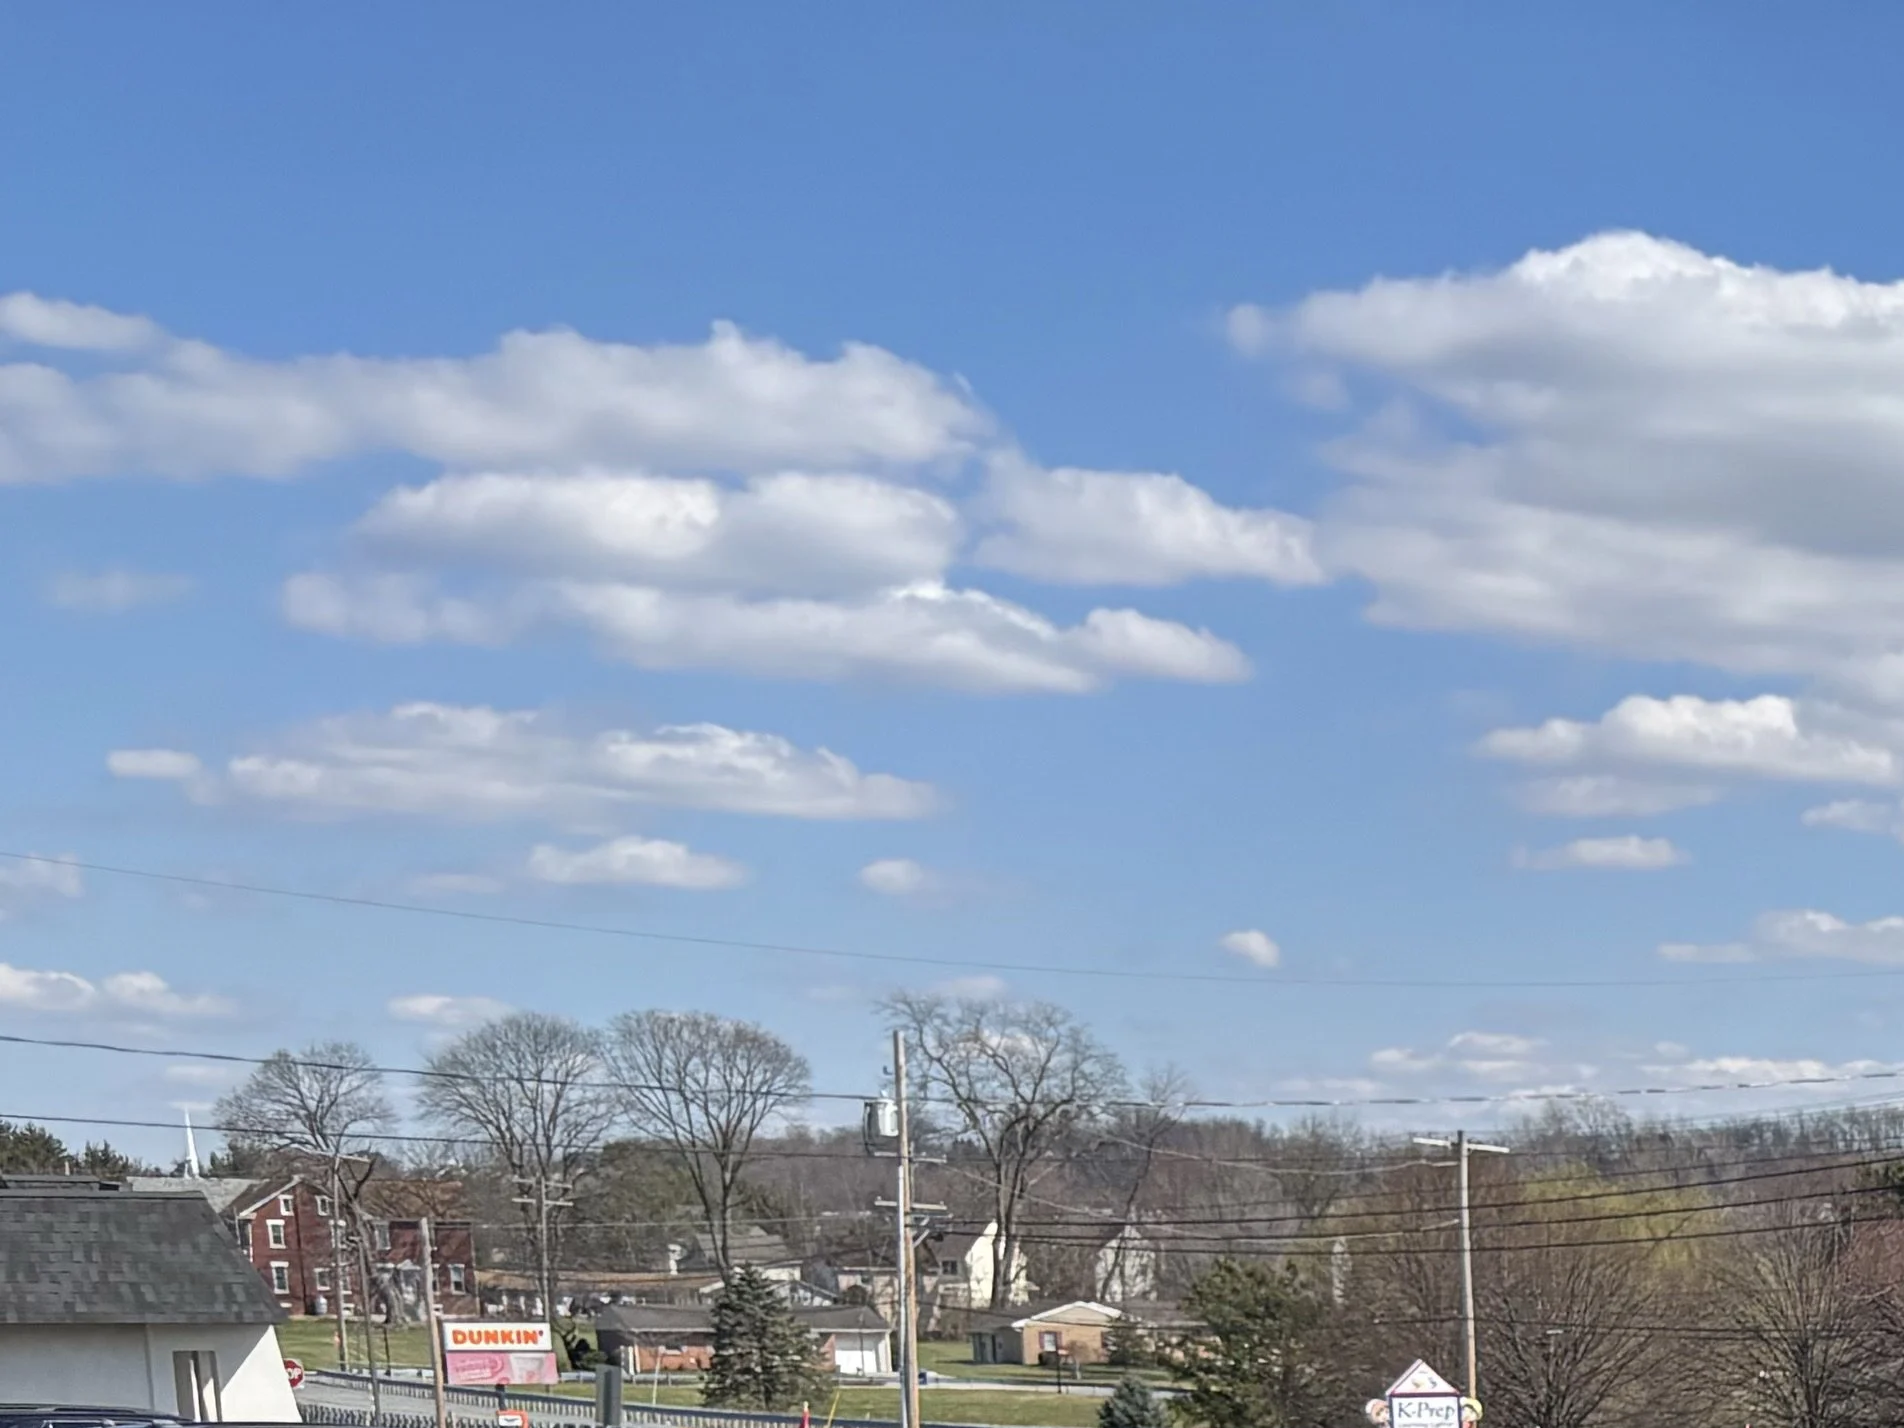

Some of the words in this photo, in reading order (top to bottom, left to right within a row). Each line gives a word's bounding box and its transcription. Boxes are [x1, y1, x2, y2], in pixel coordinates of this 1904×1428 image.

[451, 1328, 544, 1345] DUNKIN'
[286, 1367, 302, 1379] OP
[1397, 1401, 1456, 1420] K-Prep
